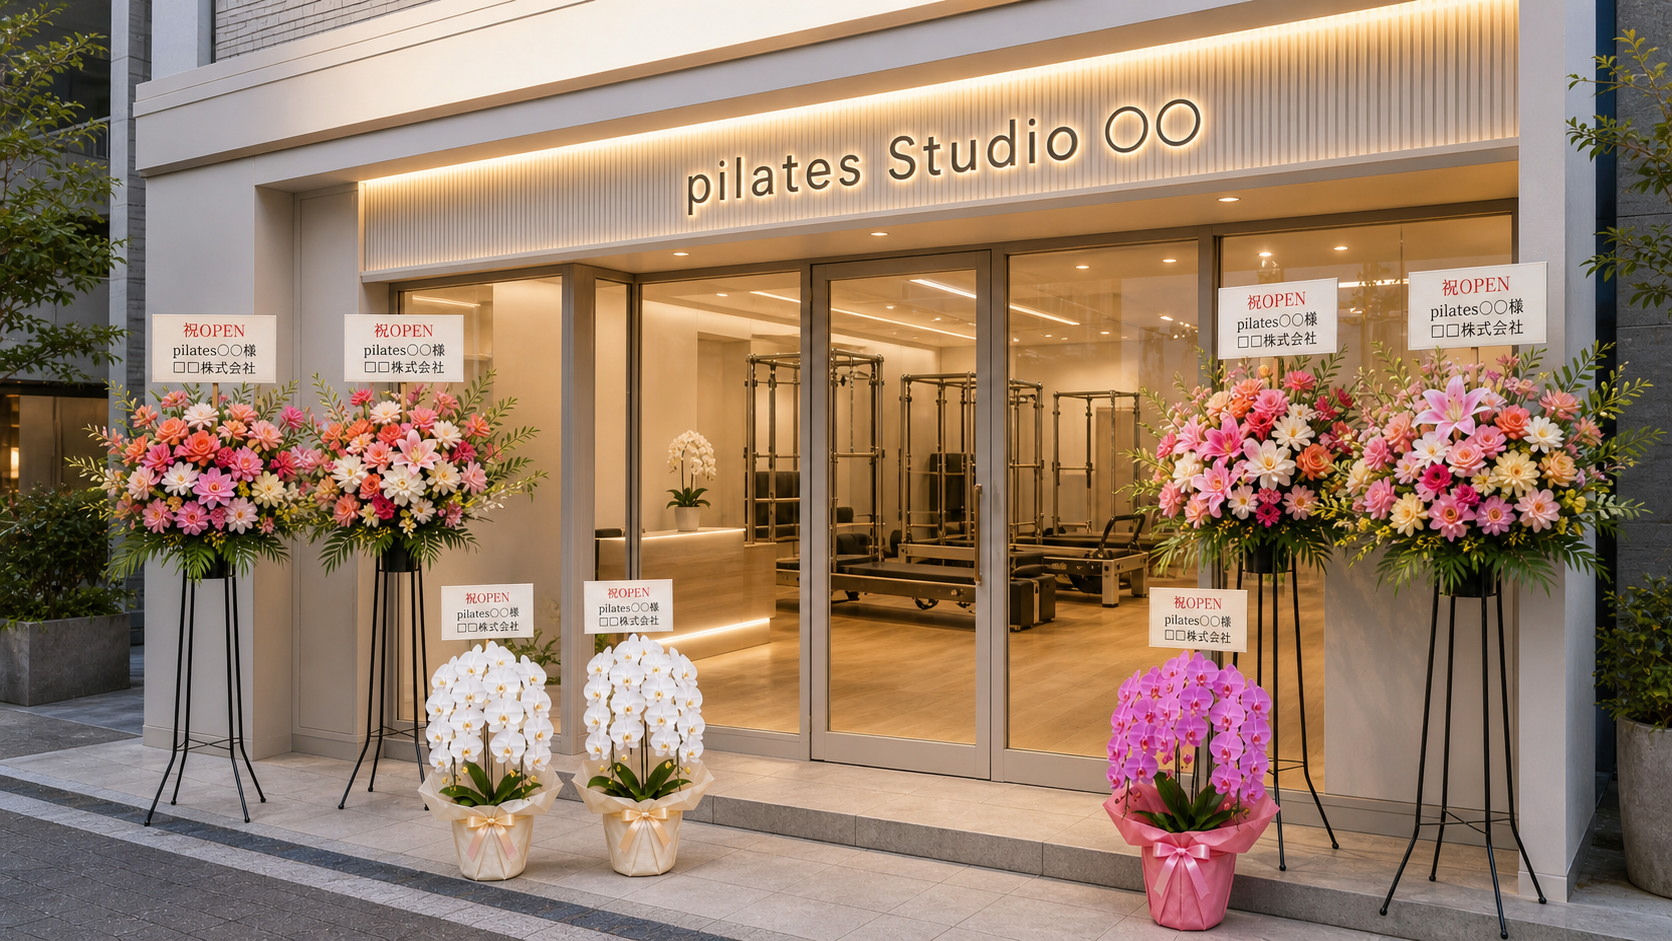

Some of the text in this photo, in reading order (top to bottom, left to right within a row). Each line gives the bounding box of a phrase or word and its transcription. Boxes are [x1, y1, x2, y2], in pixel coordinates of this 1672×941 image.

[687, 153, 862, 215] pilates
[888, 118, 1079, 181] Studio
[1442, 275, 1511, 297] 祝OPEN
[1247, 291, 1306, 311] 祝OPEN
[183, 322, 245, 338] 祝OPEN
[374, 322, 434, 338] 祝OPEN
[465, 591, 510, 605] 祝OPEN
[607, 586, 650, 599] 祝OPEN
[1174, 595, 1223, 610] 祝OPEN
